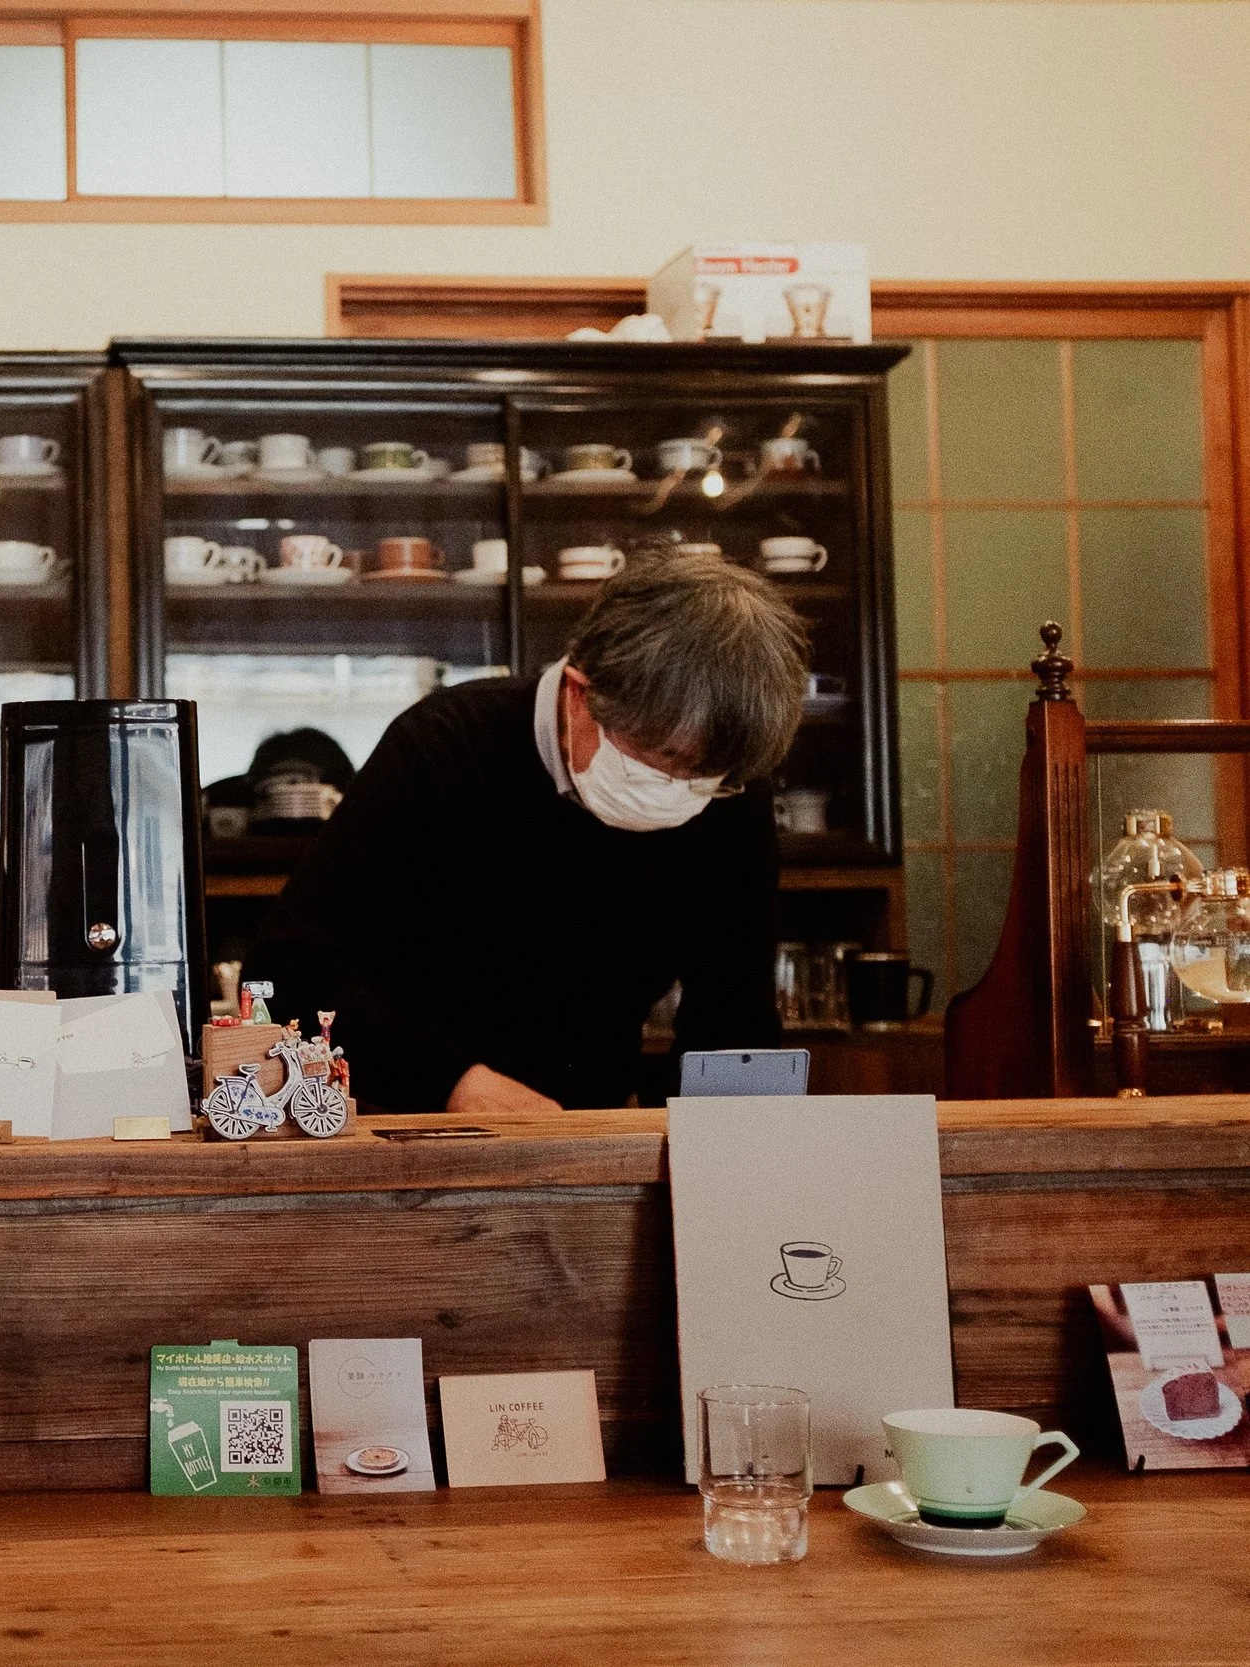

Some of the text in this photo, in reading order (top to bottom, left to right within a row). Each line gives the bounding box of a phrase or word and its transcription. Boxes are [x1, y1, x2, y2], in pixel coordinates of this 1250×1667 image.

[489, 1402, 544, 1412] LIN COFFEE
[184, 1455, 210, 1477] BOTTLE
